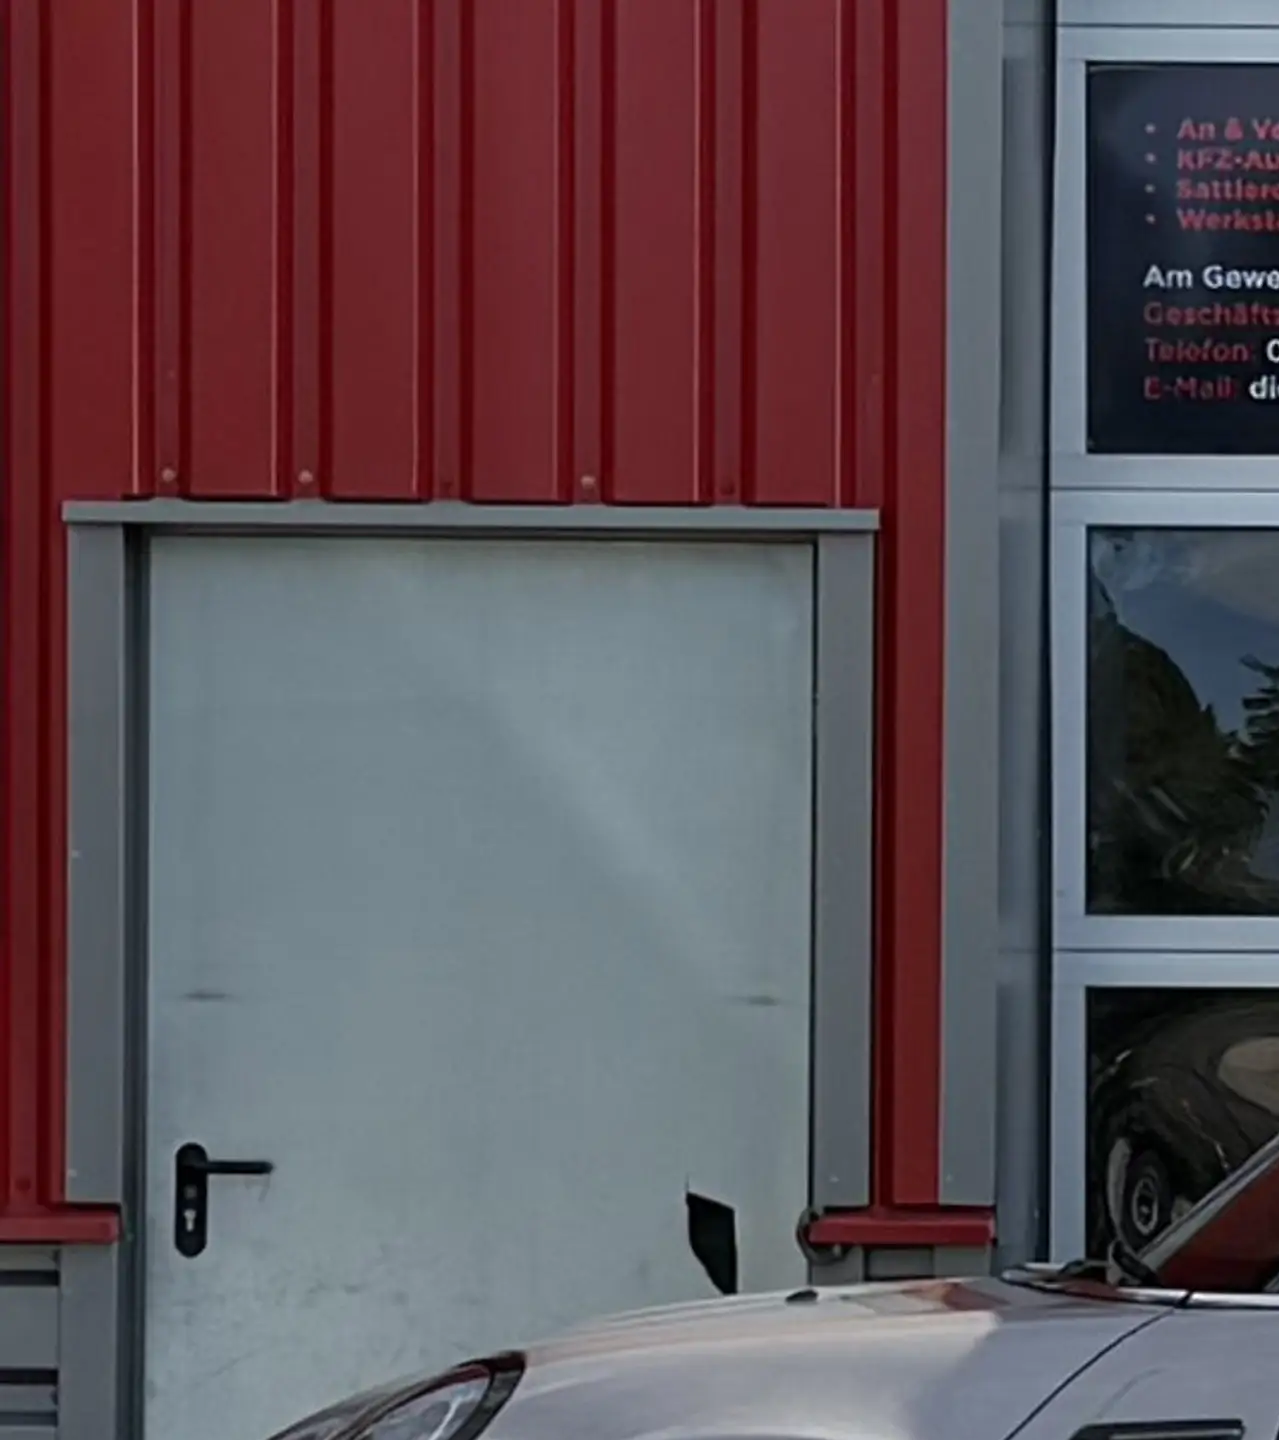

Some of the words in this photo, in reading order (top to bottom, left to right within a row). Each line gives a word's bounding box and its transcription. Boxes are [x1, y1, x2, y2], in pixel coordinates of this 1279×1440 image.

[1177, 119, 1216, 141] An
[1222, 119, 1243, 141] &
[1143, 264, 1193, 289] Am
[1145, 337, 1256, 364] Telefon:
